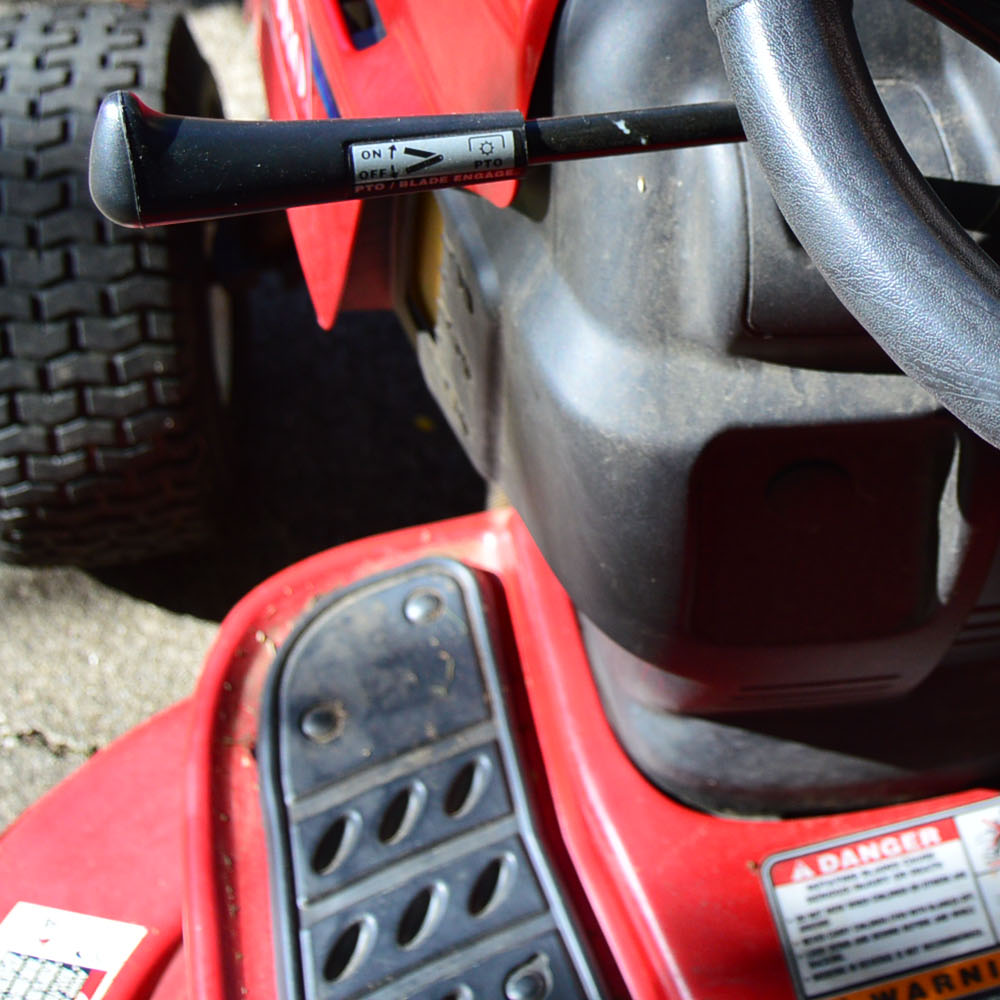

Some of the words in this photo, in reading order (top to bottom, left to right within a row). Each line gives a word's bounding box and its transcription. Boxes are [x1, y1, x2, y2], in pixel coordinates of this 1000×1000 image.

[361, 148, 383, 160] ON
[474, 158, 504, 170] PTO
[358, 168, 388, 181] OFF
[354, 182, 386, 194] PTO
[400, 175, 449, 189] BLADE
[816, 825, 943, 876] DANGER
